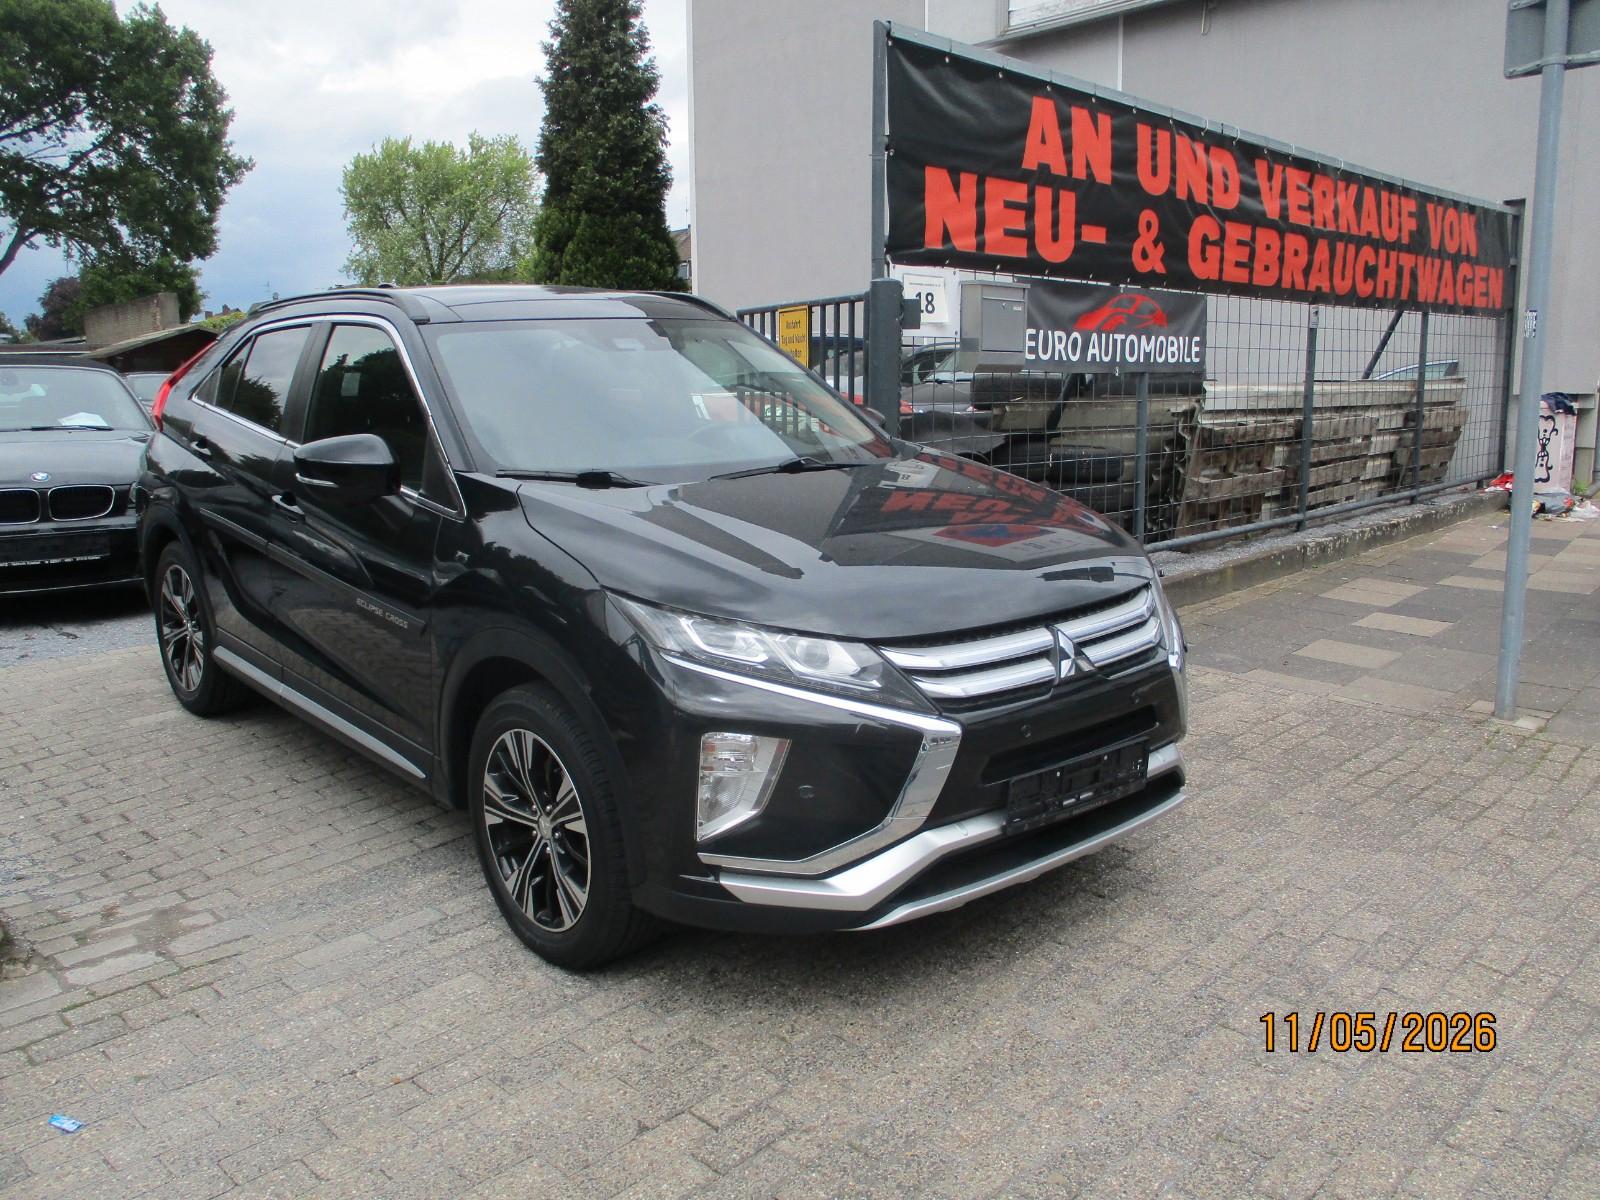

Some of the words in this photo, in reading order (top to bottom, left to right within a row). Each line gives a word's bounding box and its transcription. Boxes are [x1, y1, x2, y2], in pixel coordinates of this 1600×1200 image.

[1023, 97, 1112, 184] AN
[1137, 124, 1240, 209] UND
[1256, 160, 1417, 244] VERKAUF
[1427, 204, 1477, 256] VON
[925, 167, 1106, 262] NEU-
[1132, 210, 1165, 273] &
[1189, 216, 1503, 308] GEBRAUCHTWAGEN
[1025, 329, 1082, 360] EURO
[1087, 333, 1200, 363] AUTOMOBILE
[356, 598, 383, 616] ECLIPSE
[385, 612, 408, 629] CROSS
